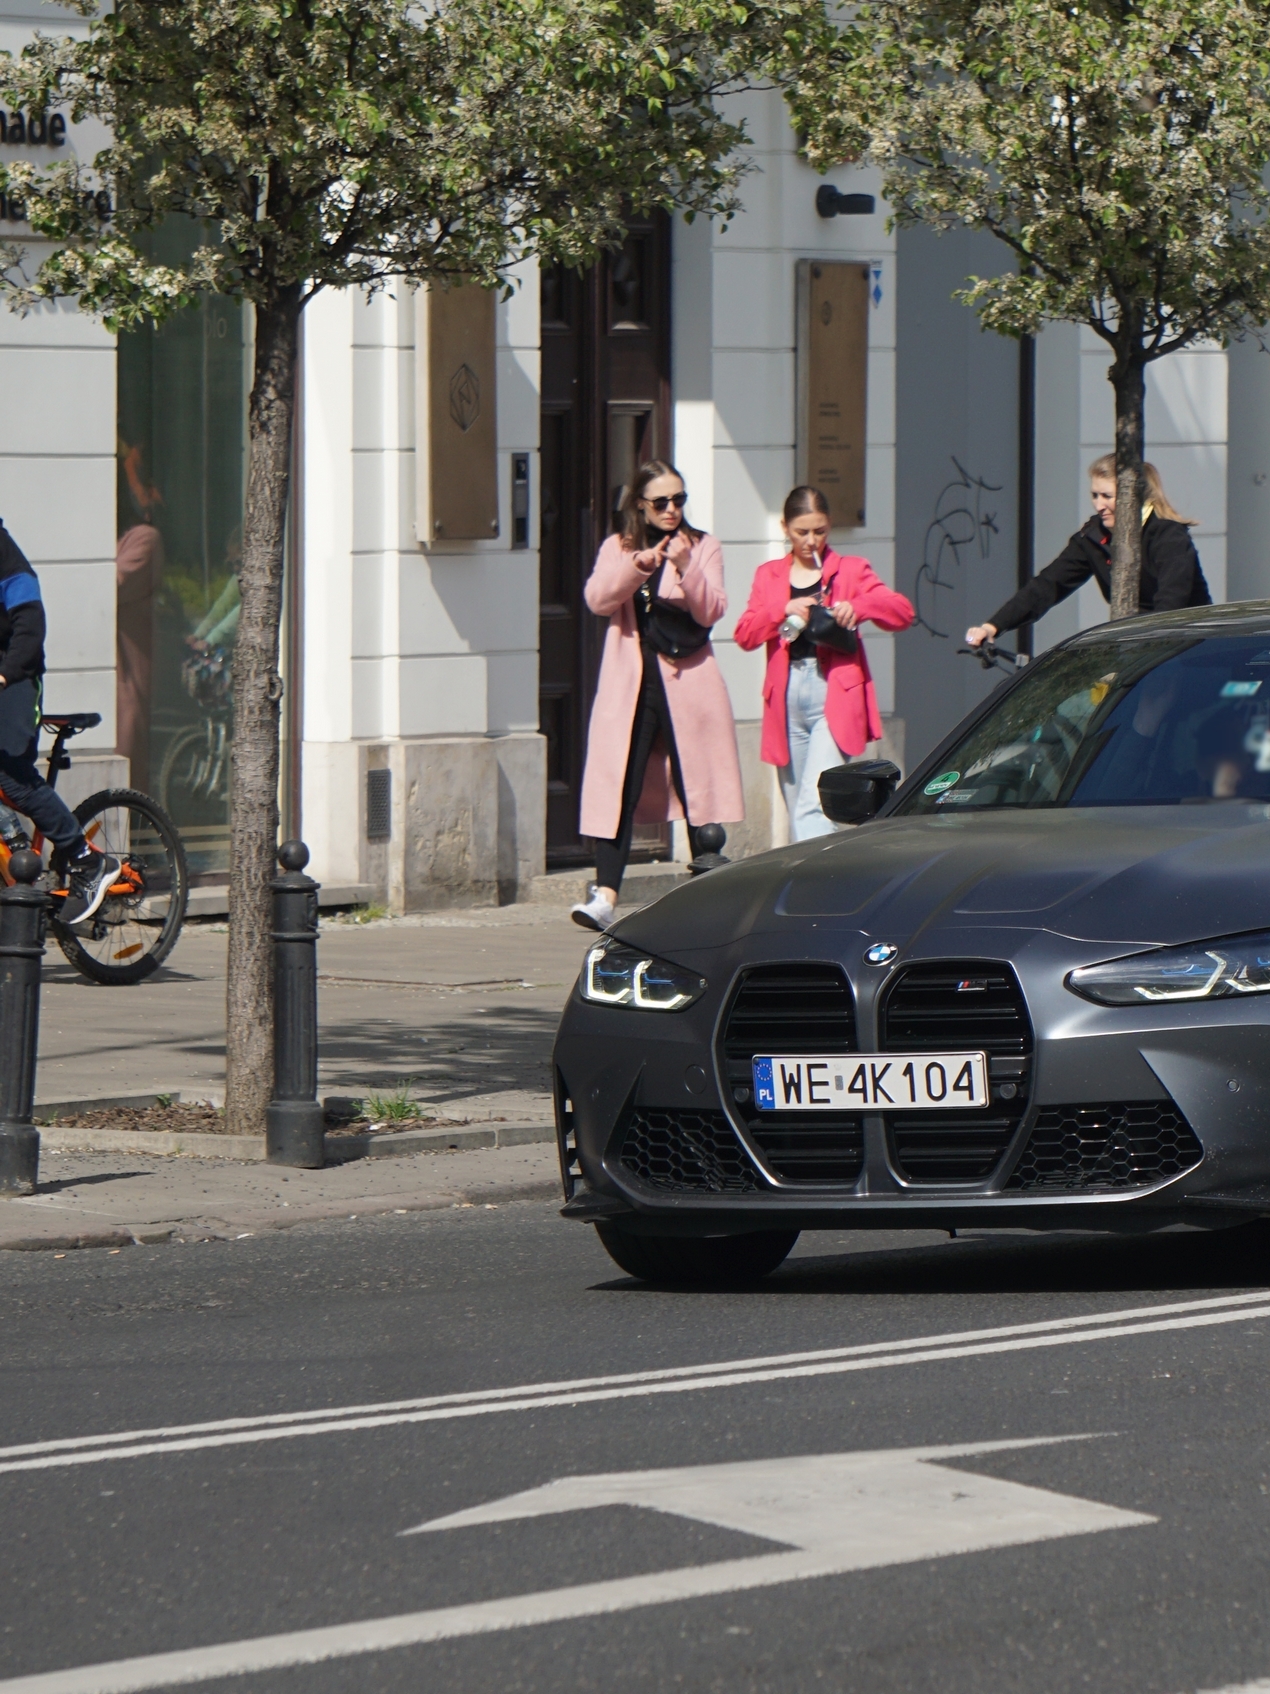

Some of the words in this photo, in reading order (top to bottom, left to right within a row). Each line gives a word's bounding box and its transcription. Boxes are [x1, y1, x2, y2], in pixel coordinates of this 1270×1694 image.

[759, 1089, 773, 1101] PL
[780, 1063, 831, 1104] WE
[848, 1060, 975, 1104] 4K104
